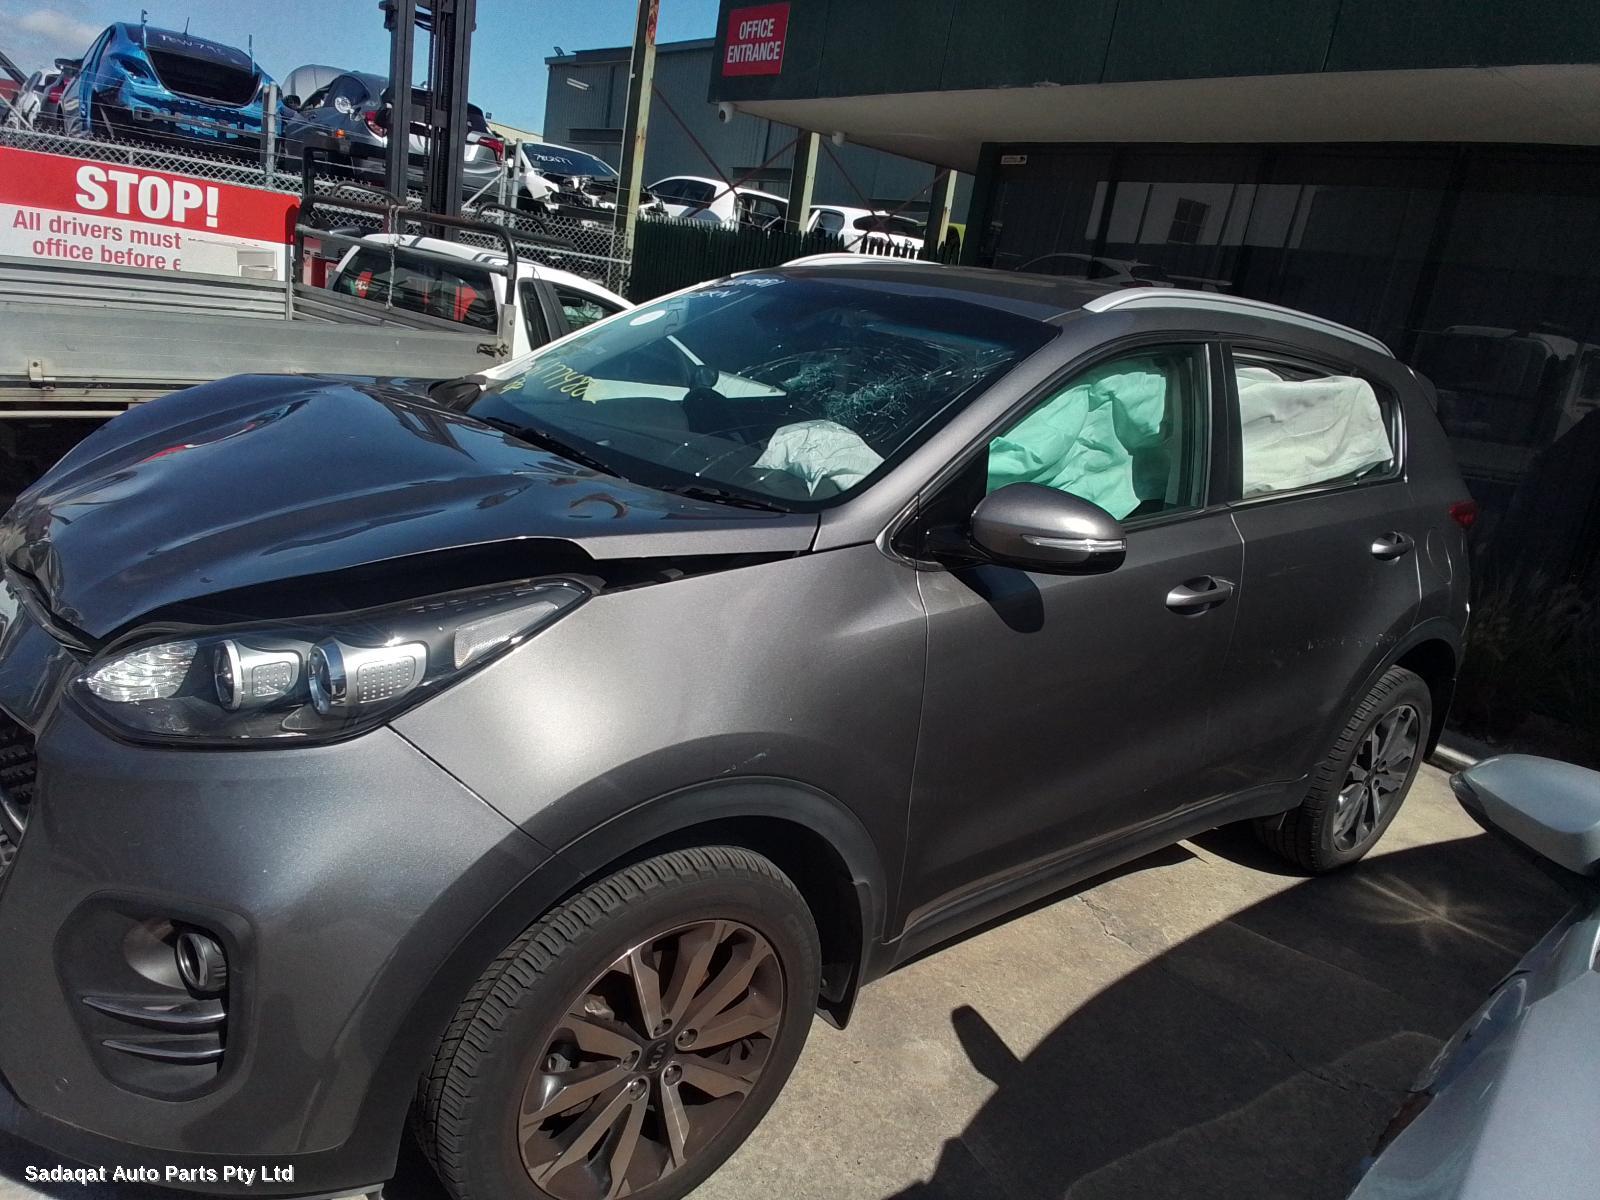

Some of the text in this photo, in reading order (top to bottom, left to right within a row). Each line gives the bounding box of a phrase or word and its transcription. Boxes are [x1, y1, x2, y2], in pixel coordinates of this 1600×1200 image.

[739, 18, 775, 40] OFFICE
[727, 41, 781, 63] ENTRANCE
[75, 165, 219, 228] STOP!
[12, 209, 182, 250] All drivers must
[32, 238, 94, 261] office
[101, 244, 167, 270] before
[648, 1042, 667, 1069] KIA
